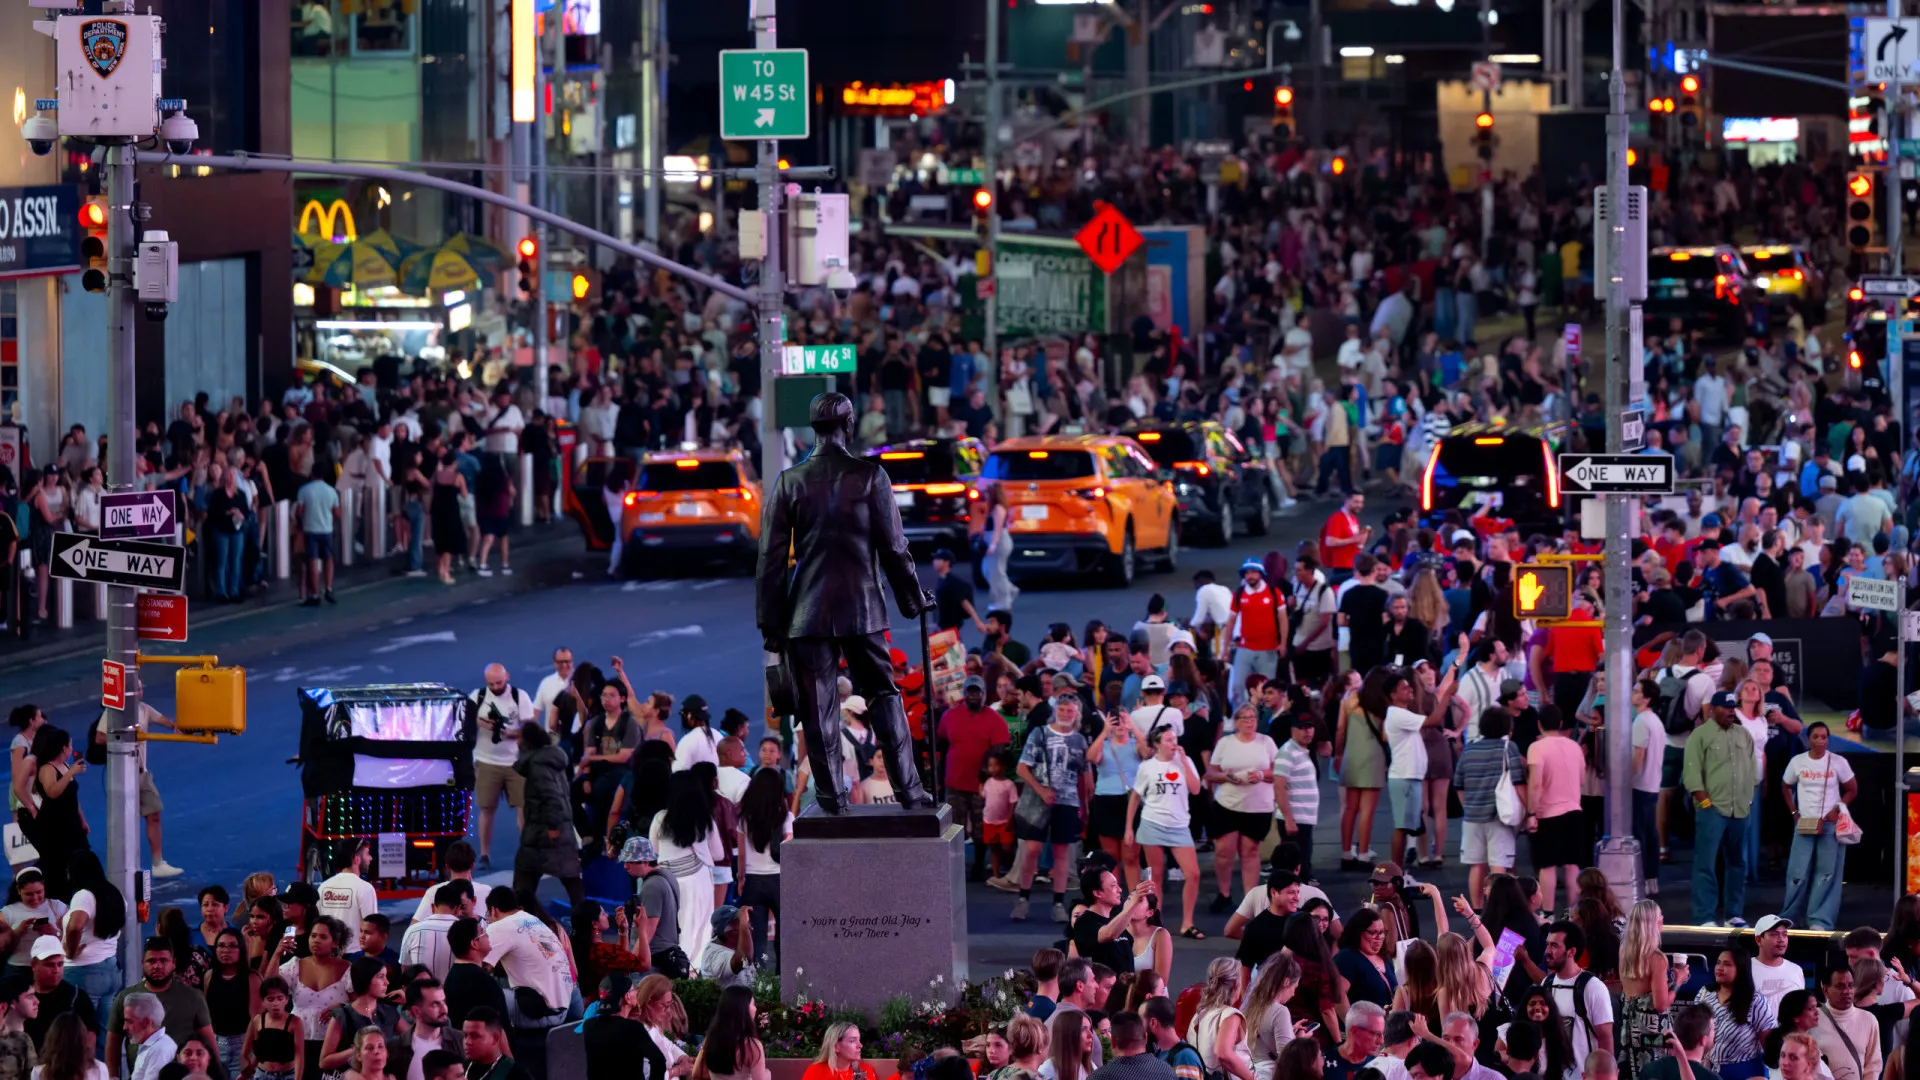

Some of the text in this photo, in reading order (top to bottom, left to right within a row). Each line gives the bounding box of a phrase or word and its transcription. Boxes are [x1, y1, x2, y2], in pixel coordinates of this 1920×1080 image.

[92, 22, 117, 30] POLICE
[83, 29, 125, 39] DEPARTMENT
[753, 61, 775, 77] TO
[1874, 65, 1911, 78] ONLY
[733, 84, 796, 101] W 45 St
[159, 99, 183, 110] NYPD
[12, 195, 61, 238] ASSN.
[805, 347, 852, 370] W 46 St
[1577, 467, 1658, 481] ONE WAY
[111, 505, 164, 526] ONE WAY
[72, 549, 166, 575] ONE WAY
[147, 599, 174, 609] STANDING
[1158, 773, 1164, 782] I
[1155, 783, 1182, 795] NY
[811, 916, 837, 928] You're
[849, 916, 879, 928] Grand
[881, 915, 898, 926] Old
[900, 913, 921, 928] Flag
[842, 927, 890, 938] Over There
